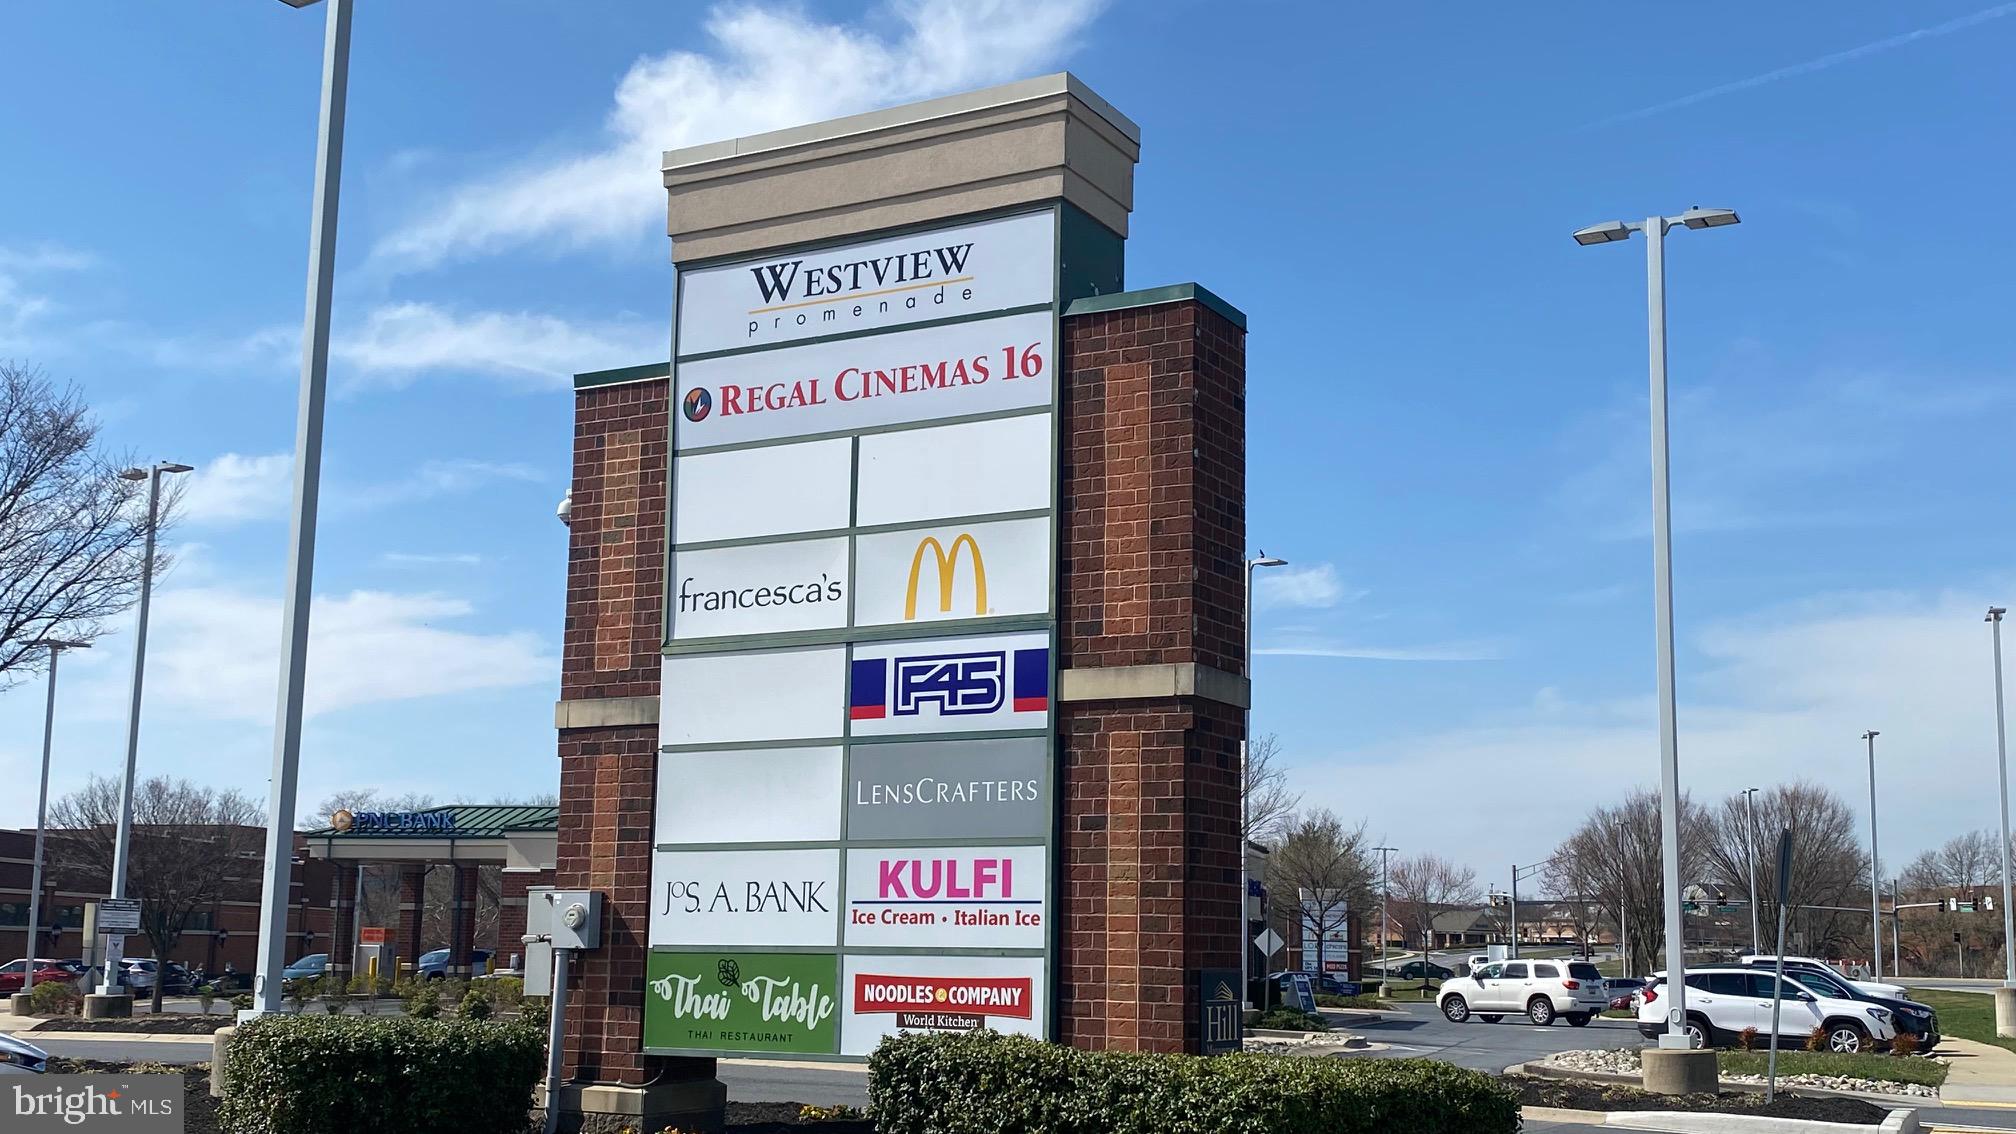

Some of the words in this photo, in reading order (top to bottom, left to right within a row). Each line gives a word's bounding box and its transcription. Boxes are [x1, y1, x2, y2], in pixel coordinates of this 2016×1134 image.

[750, 243, 974, 304] WESTVIEW
[748, 285, 973, 337] promenade
[719, 379, 827, 417] REGAL
[834, 356, 990, 402] CINEMAS
[1002, 342, 1044, 380] 16
[679, 573, 842, 613] francesca's
[893, 650, 1006, 717] F45
[856, 777, 1039, 806] LENSCRAFTERS
[355, 811, 398, 829] PNC
[400, 812, 456, 829] BANK
[708, 881, 739, 913] A.
[745, 881, 830, 913] BANK
[879, 859, 1012, 899] KULFI
[851, 909, 876, 925] Ice
[881, 909, 935, 925] Cream
[954, 910, 1010, 926] Italian
[1014, 910, 1041, 926] Ice
[649, 974, 731, 1020] Thai
[741, 976, 835, 1031] Table
[864, 984, 934, 1004] NOODLES
[949, 986, 1023, 1007] COMPANY
[688, 1030, 713, 1040] THAI
[720, 1032, 793, 1043] RESTAURANT
[903, 1014, 935, 1027] World
[937, 1015, 978, 1028] Kitchen
[1206, 1004, 1239, 1042] Hill
